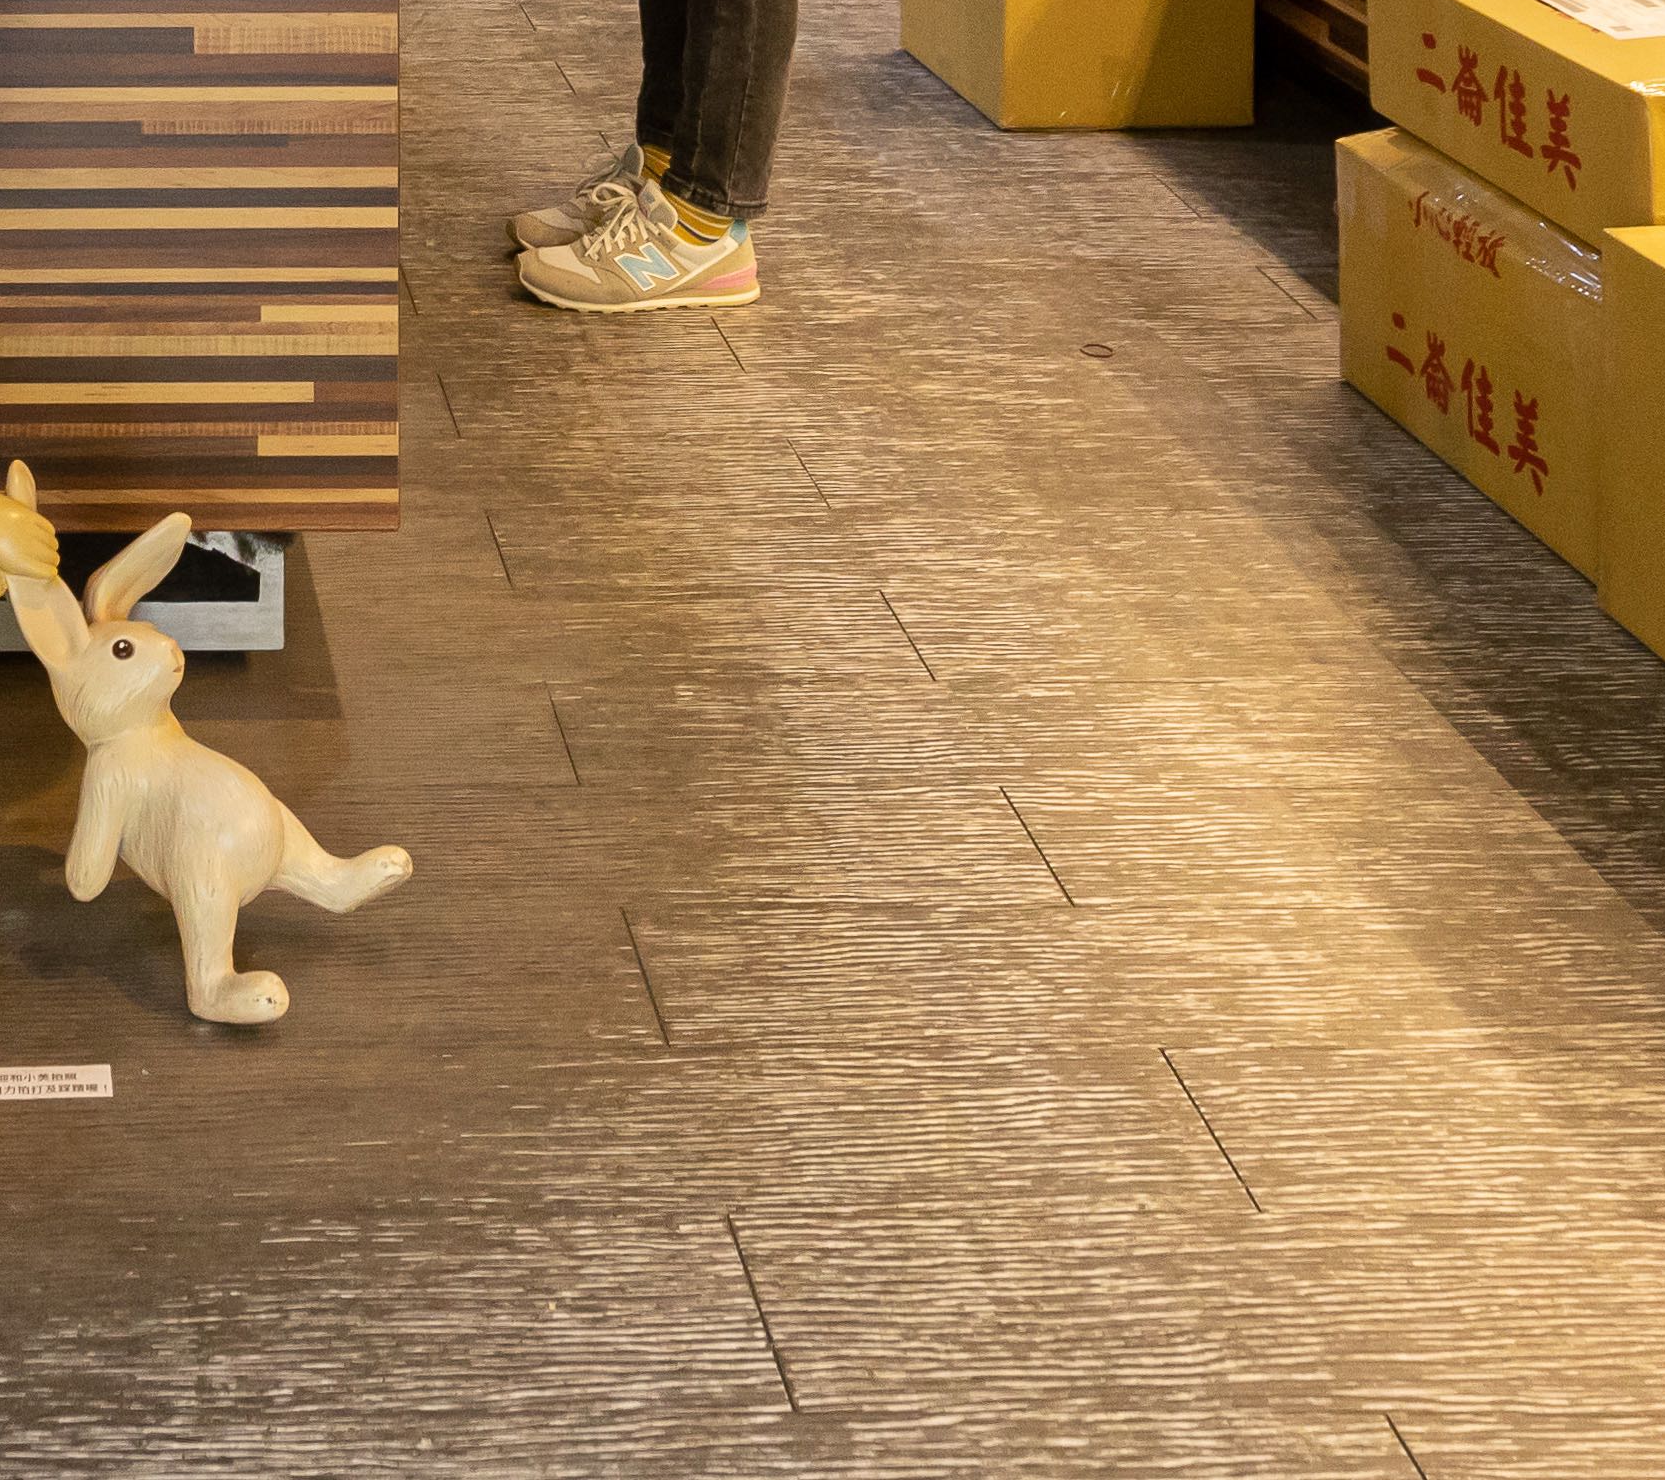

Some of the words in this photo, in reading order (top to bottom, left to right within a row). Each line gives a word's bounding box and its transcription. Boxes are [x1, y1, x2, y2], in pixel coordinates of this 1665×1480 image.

[1416, 32, 1582, 192] 二崙佳美
[1385, 313, 1549, 496] 二崙佳美
